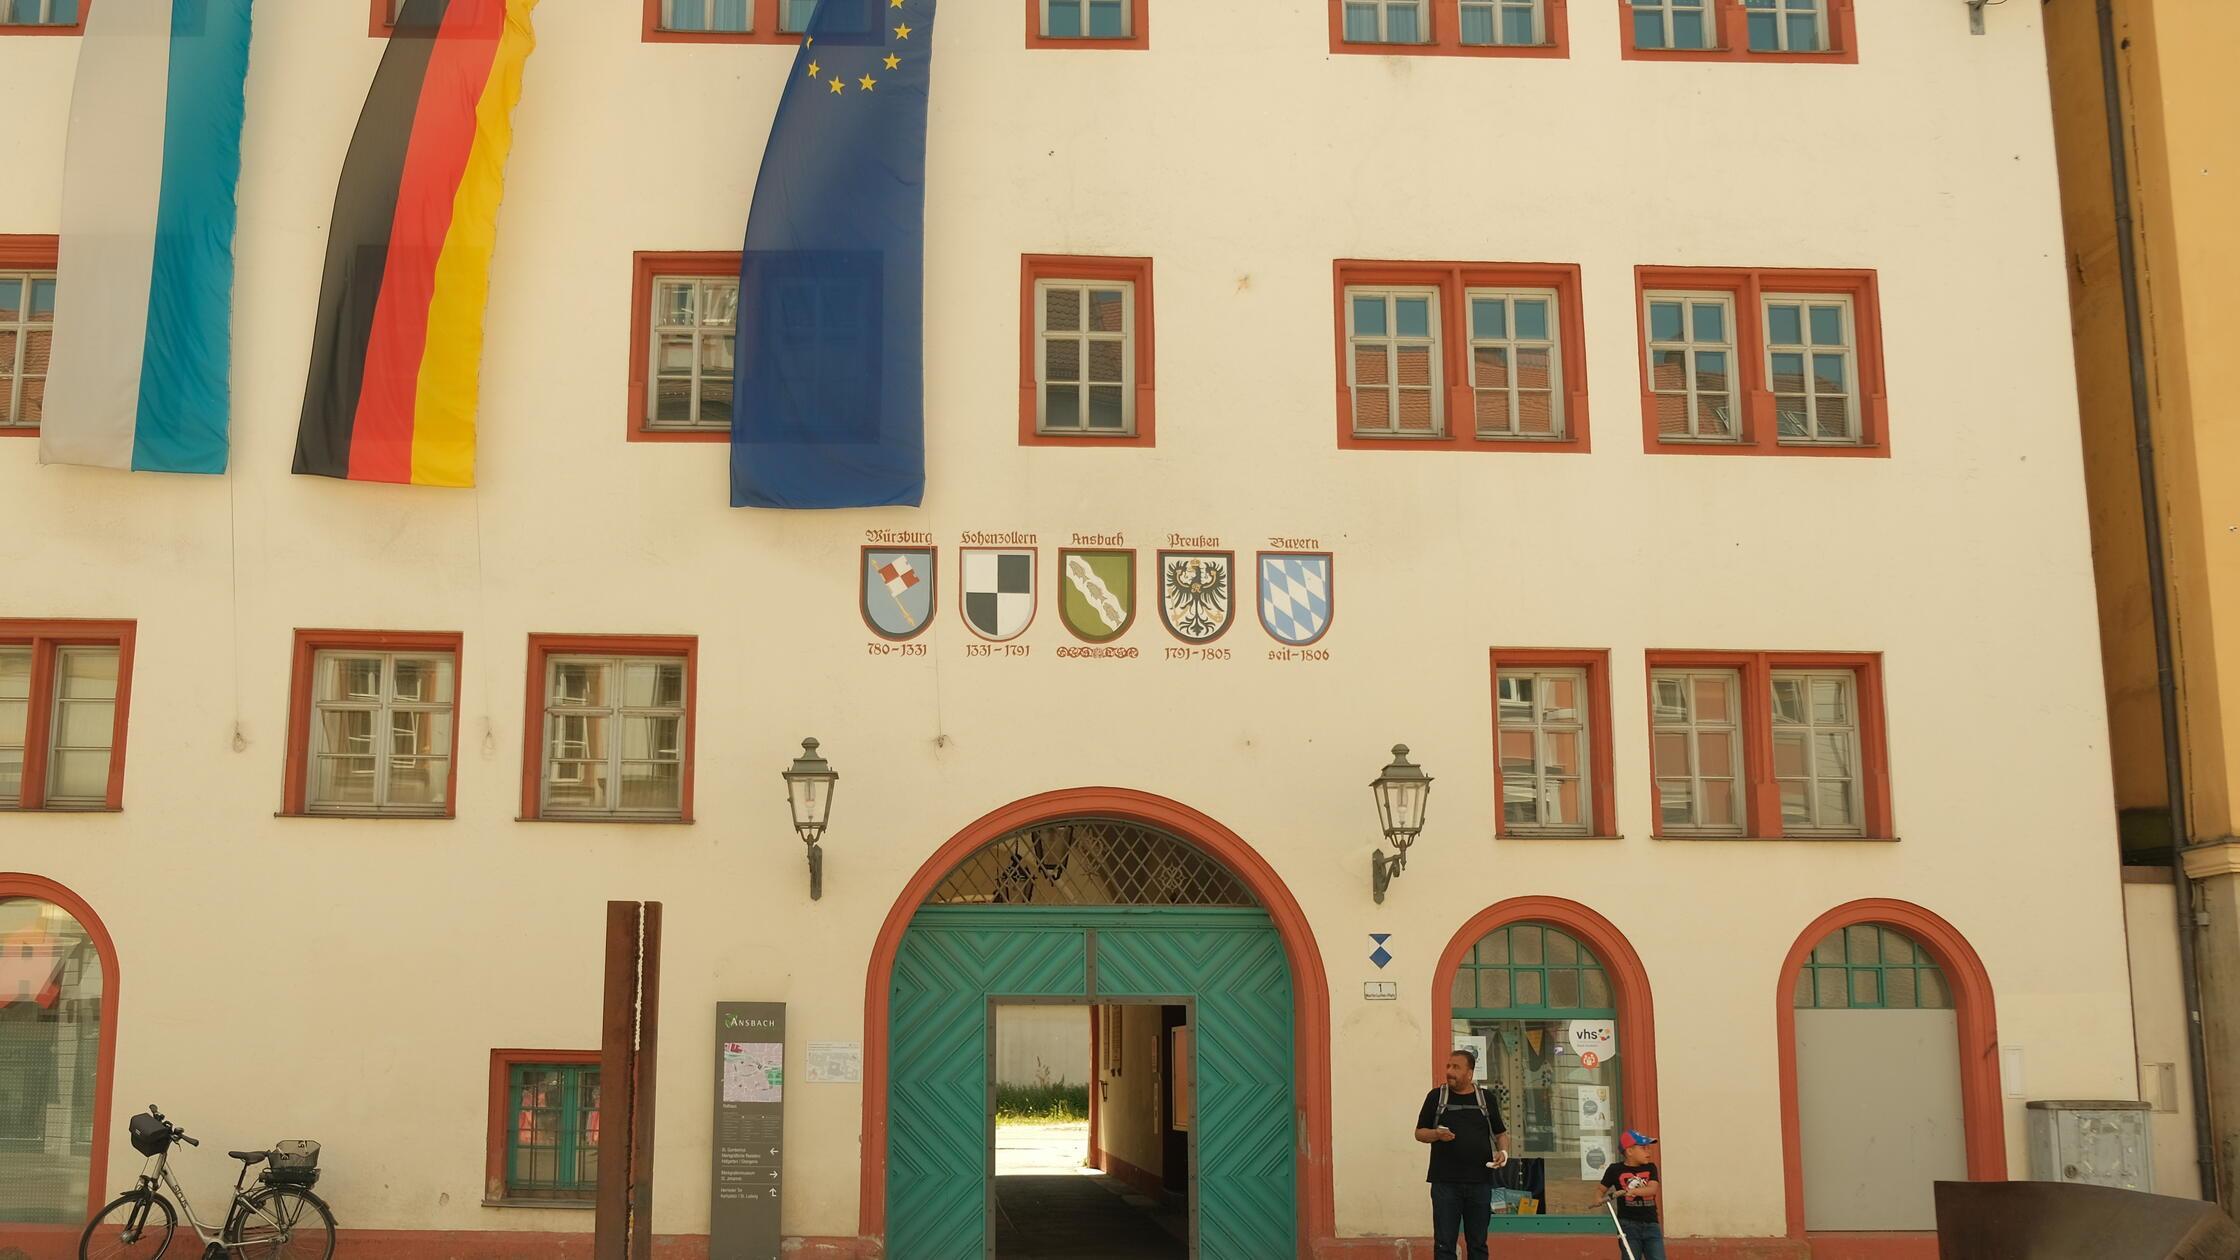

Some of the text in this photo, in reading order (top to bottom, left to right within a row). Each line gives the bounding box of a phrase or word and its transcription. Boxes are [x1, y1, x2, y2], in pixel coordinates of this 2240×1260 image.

[865, 529, 933, 545] Würzburg
[961, 530, 1038, 546] Hohenzollern
[1071, 532, 1124, 546] Ansbach
[1167, 533, 1220, 548] Preußen
[1268, 537, 1319, 549] Bayern
[1378, 983, 1382, 993] 1
[1576, 1028, 1598, 1040] vhs
